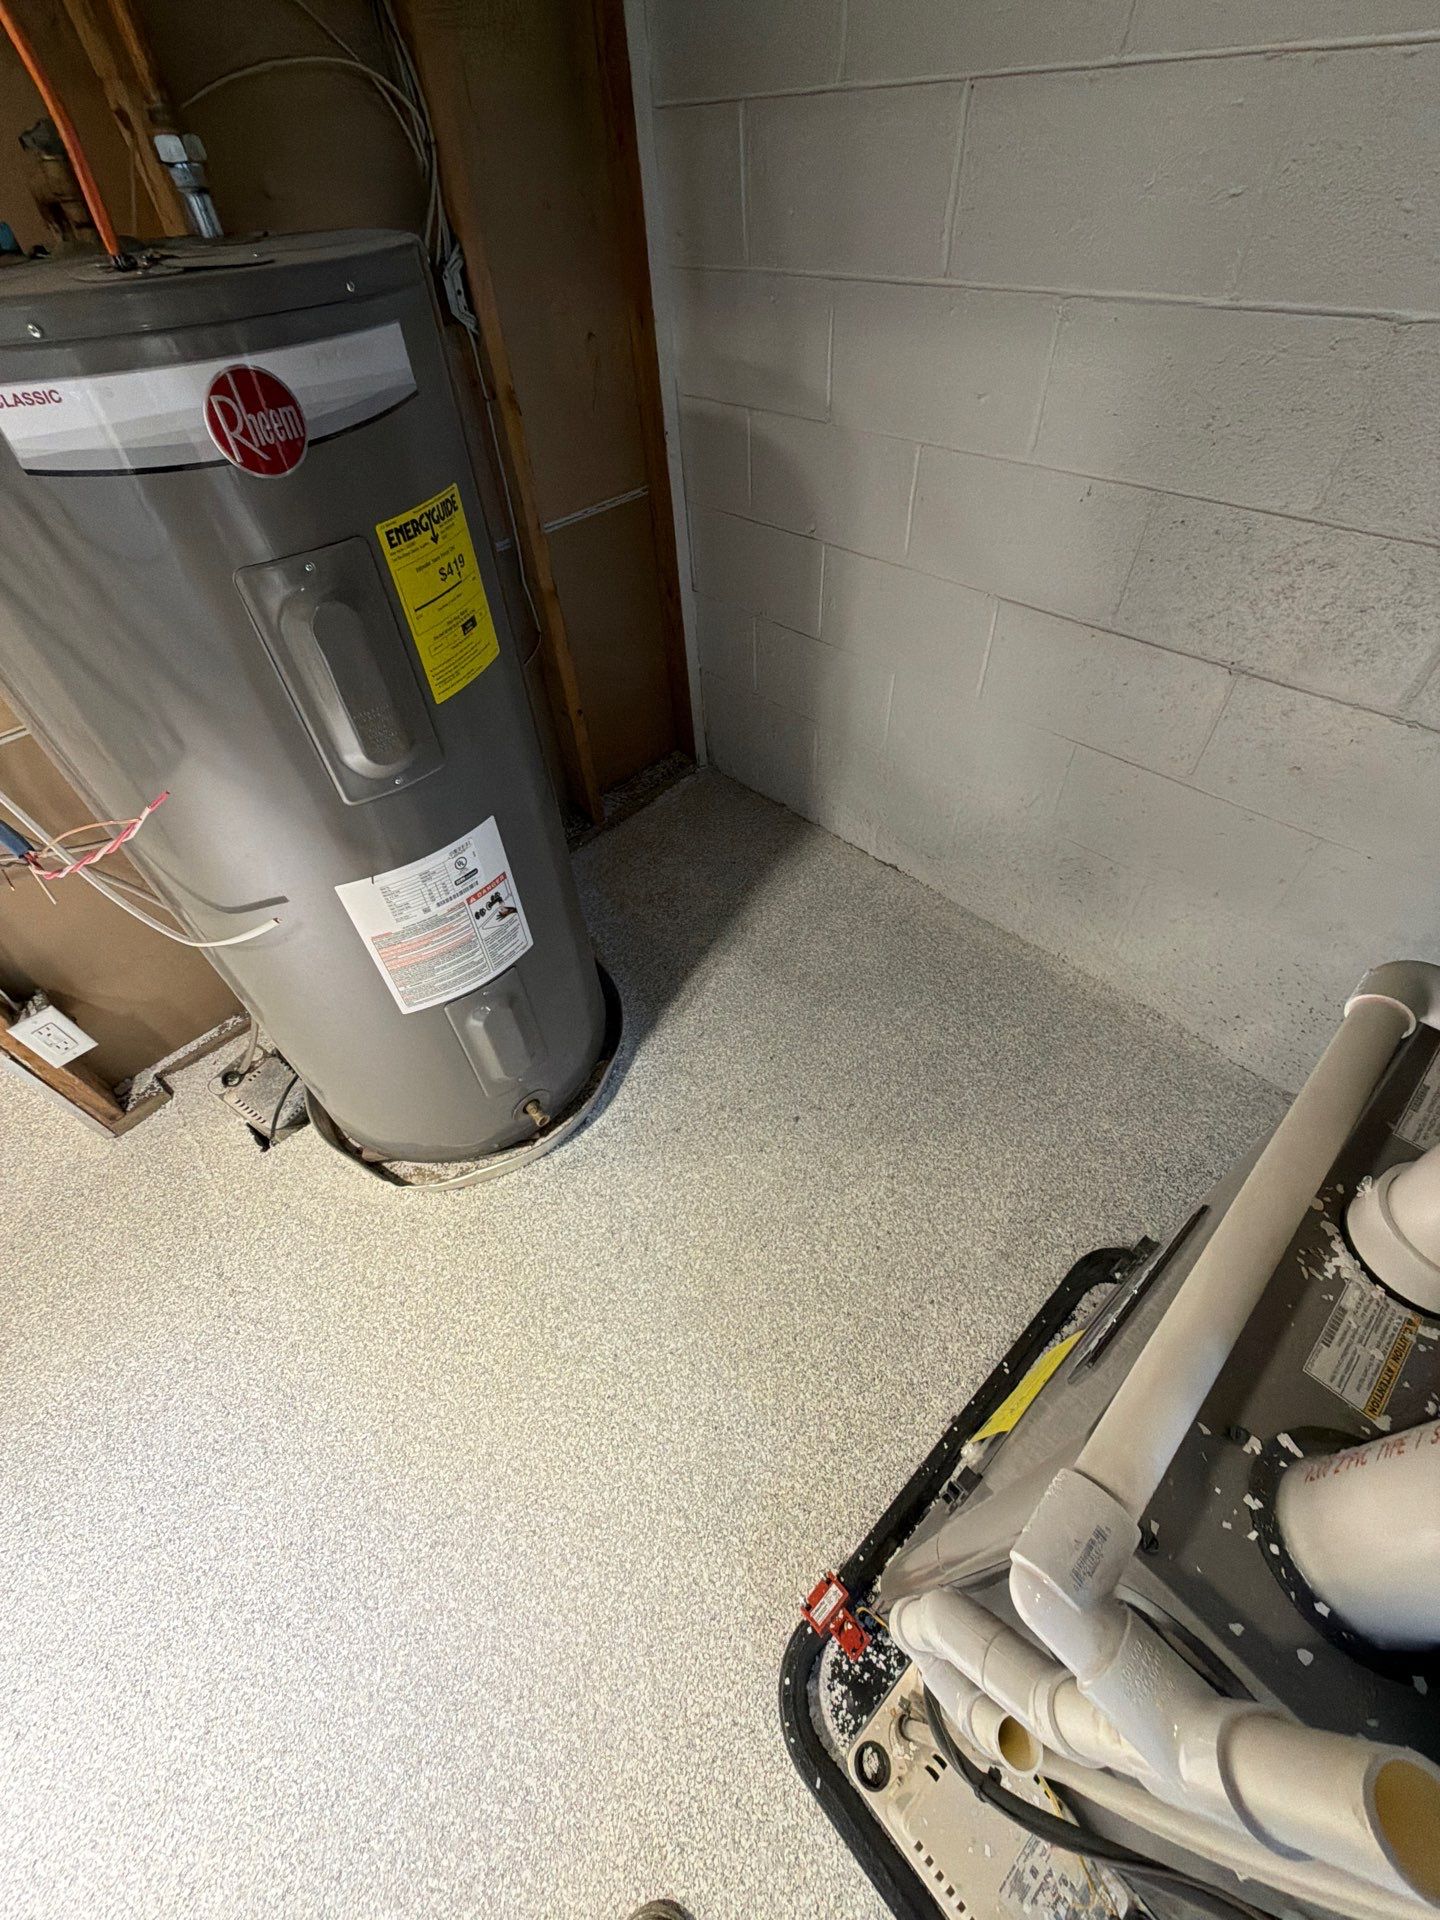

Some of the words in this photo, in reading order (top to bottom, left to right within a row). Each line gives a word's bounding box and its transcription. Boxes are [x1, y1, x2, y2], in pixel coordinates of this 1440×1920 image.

[0, 389, 63, 409] LASSIC
[209, 371, 305, 464] Rheem
[438, 553, 465, 582] $419
[477, 873, 505, 899] DANGER
[1368, 1366, 1396, 1415] ATTENTION
